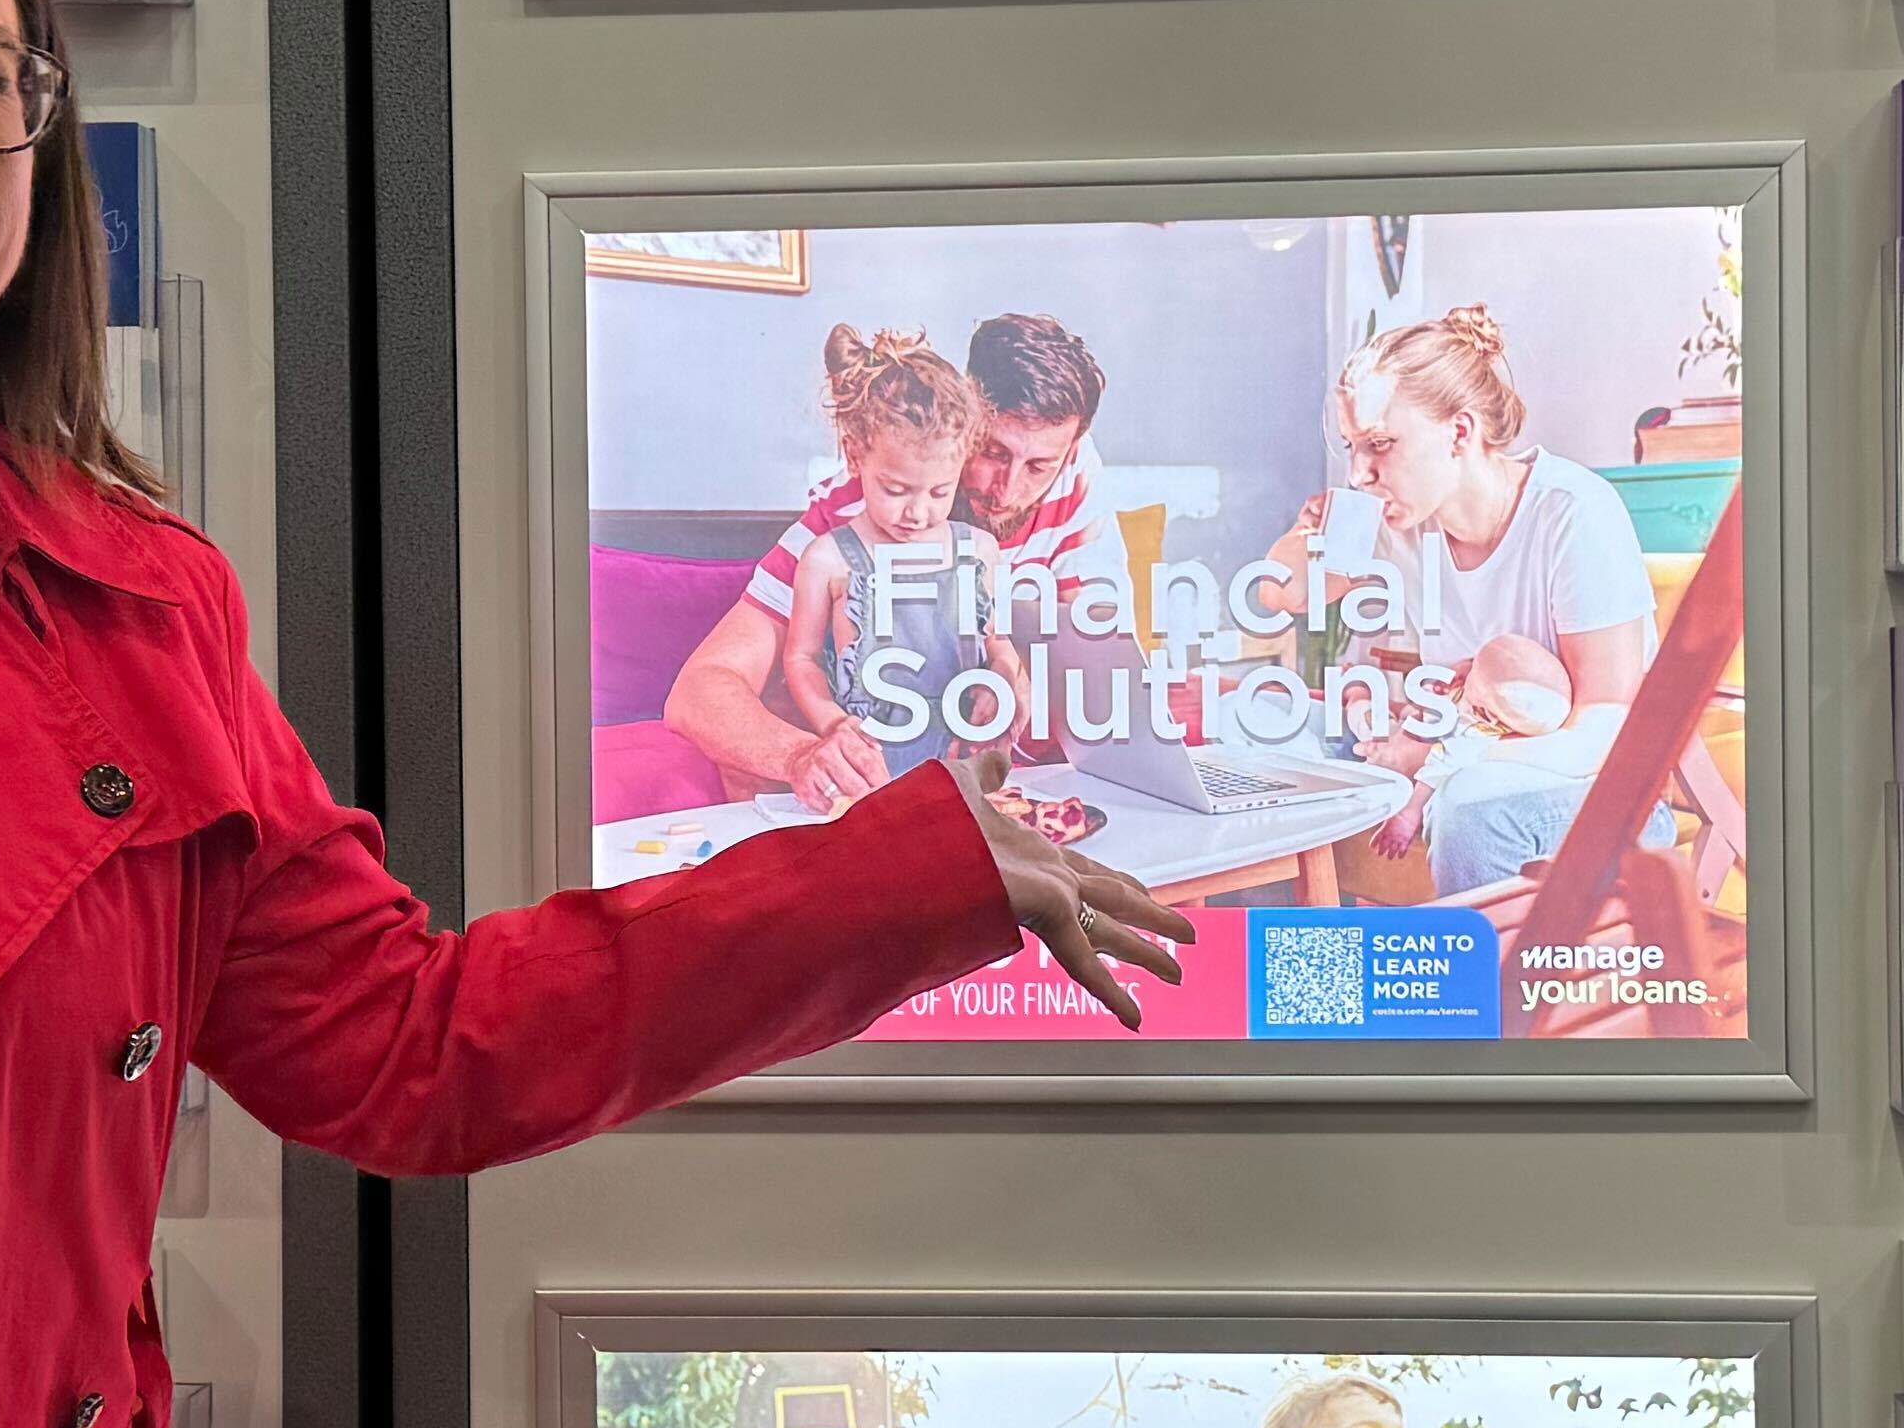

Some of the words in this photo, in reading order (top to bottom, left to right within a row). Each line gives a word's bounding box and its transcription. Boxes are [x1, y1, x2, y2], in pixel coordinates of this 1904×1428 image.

[871, 532, 1440, 639] Financial
[859, 643, 1459, 743] Solutions
[1372, 935, 1435, 953] SCAN
[1442, 935, 1474, 952] TO
[1373, 958, 1450, 976] LEARN
[1521, 945, 1664, 976] manage
[911, 984, 941, 1016] OF
[953, 983, 1014, 1015] YOUR
[1023, 982, 1141, 1015] FINANS
[1373, 980, 1439, 999] MORE
[1521, 978, 1602, 1011] your
